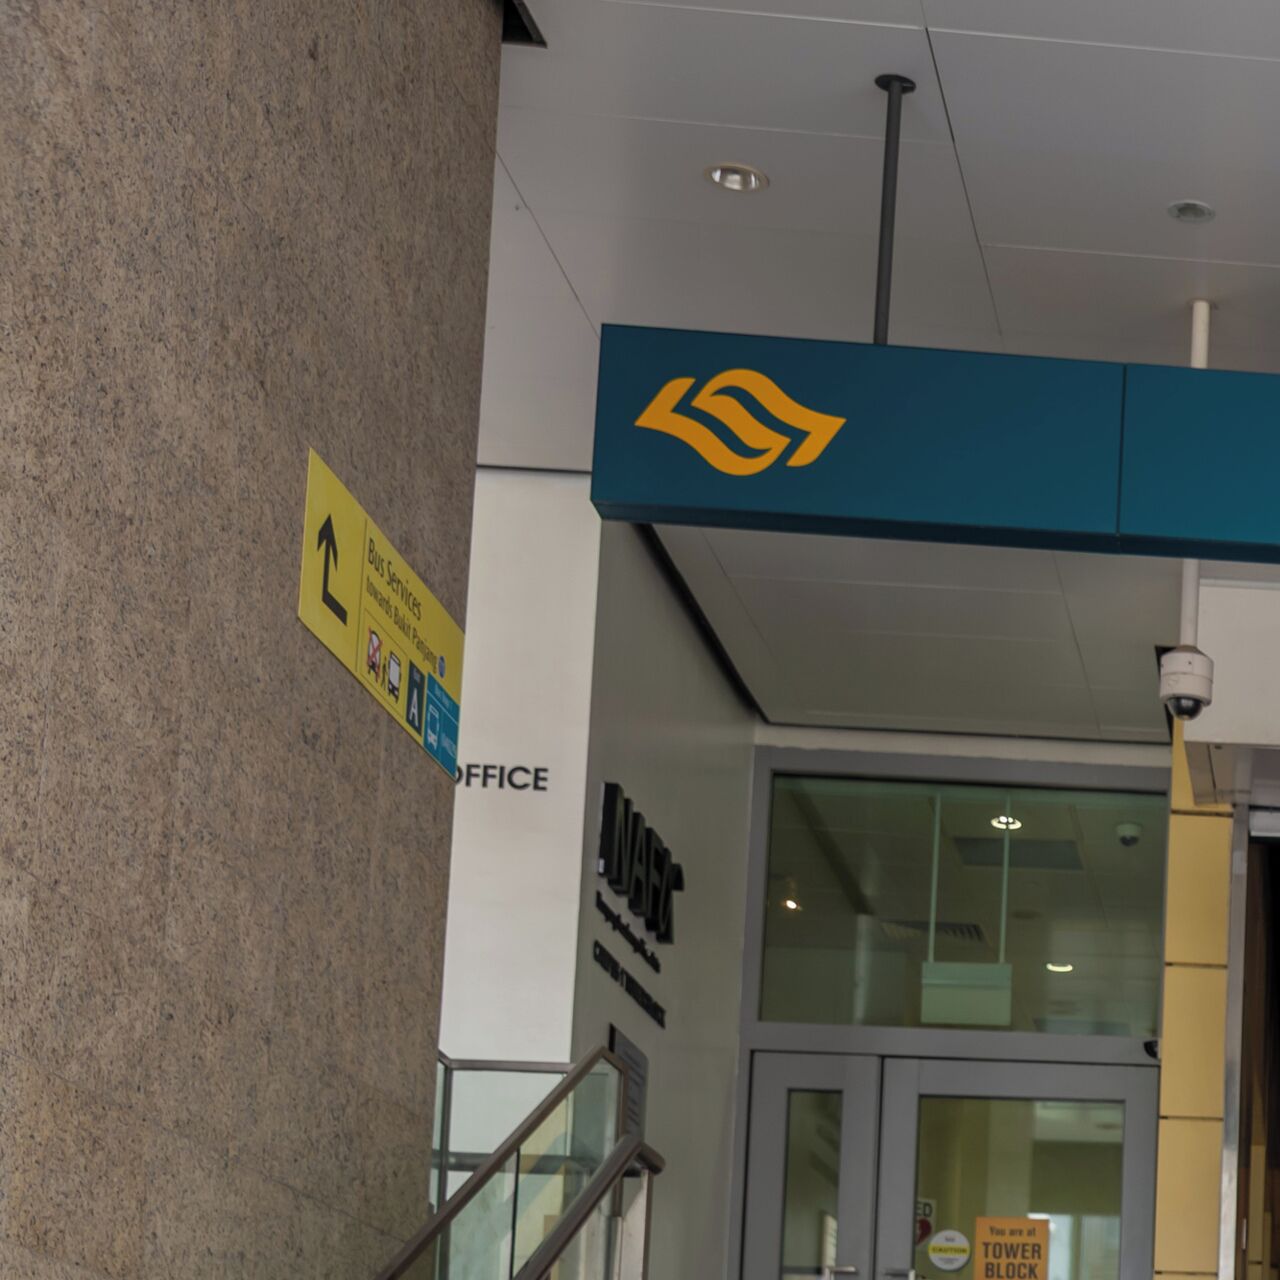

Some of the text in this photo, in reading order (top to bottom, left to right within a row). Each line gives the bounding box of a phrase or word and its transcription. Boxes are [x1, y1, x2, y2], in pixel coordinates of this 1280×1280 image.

[367, 538, 422, 621] Bus Services
[366, 576, 438, 673] towards Bukit Panjang
[408, 688, 419, 727] A
[989, 1226, 1037, 1237] You are at
[982, 1241, 1042, 1260] TOWER
[984, 1262, 1039, 1280] BLOCK
